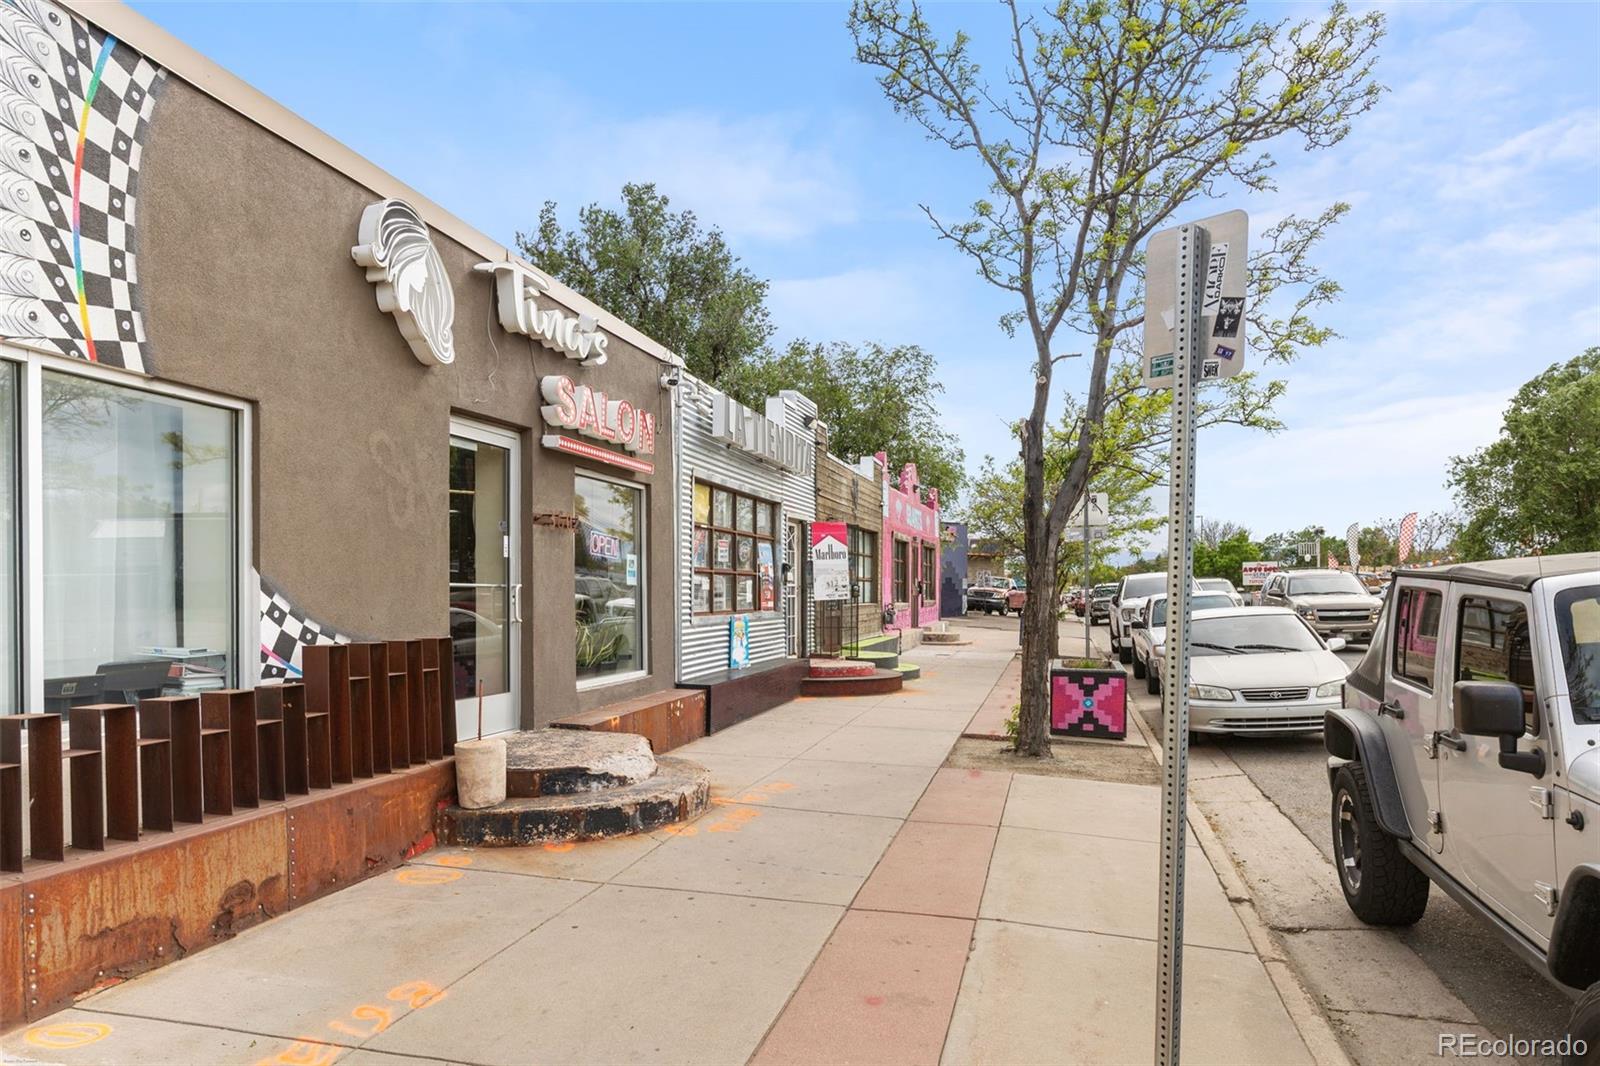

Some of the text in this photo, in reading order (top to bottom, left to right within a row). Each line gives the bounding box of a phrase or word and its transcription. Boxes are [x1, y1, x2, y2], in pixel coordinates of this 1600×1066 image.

[1214, 256, 1226, 299] DARKO
[541, 375, 655, 455] SALON
[712, 393, 747, 449] LA
[592, 534, 618, 556] OPEN
[815, 544, 847, 560] Marlboro
